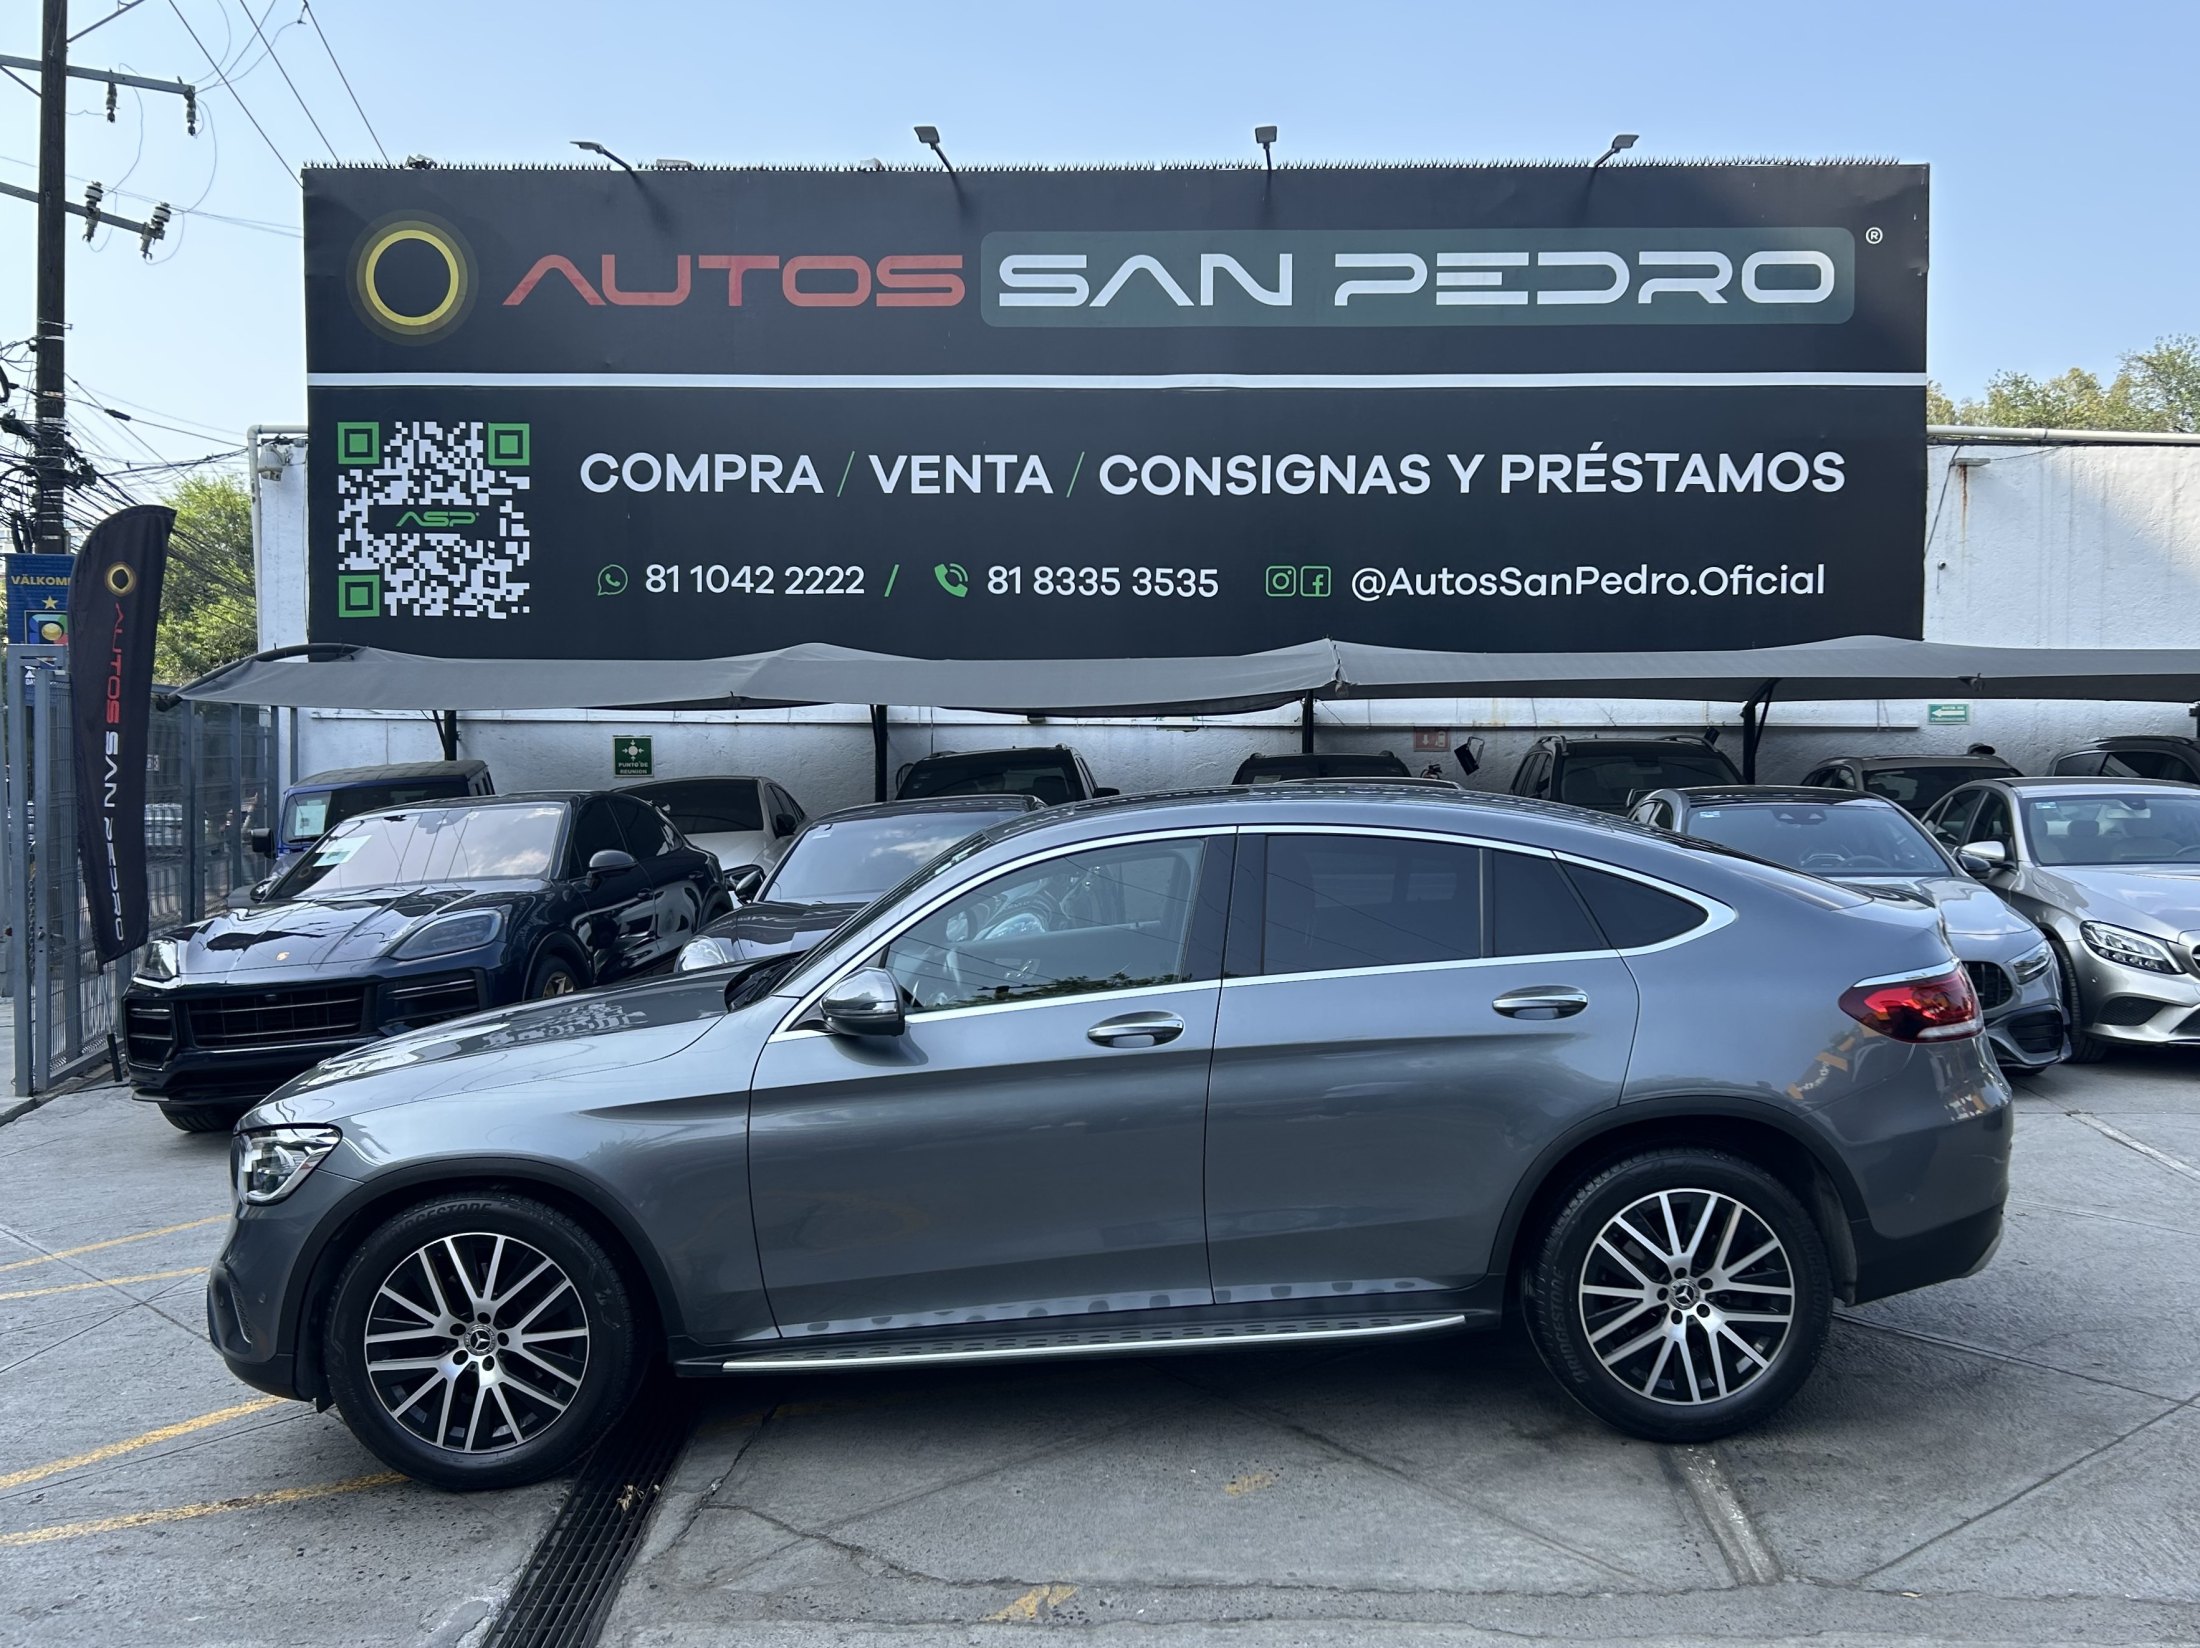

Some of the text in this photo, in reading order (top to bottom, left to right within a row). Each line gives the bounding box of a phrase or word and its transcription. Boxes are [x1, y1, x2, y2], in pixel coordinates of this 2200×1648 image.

[503, 254, 966, 307] AUTOS
[999, 252, 1293, 307] SAN
[1334, 250, 1835, 306] PEDRO
[580, 452, 825, 495] COMPRA
[868, 454, 1054, 495] VENTA
[1099, 453, 1431, 497] CONSIGNAS
[1446, 453, 1486, 495] Y
[1500, 441, 1845, 495] PRÉSTAMOS
[396, 511, 476, 527] ASP
[645, 563, 679, 594] 81
[689, 564, 775, 596] 1042
[784, 565, 865, 596] 2222
[987, 565, 1021, 596] 81
[1033, 565, 1121, 598] 8335
[1131, 566, 1219, 598] 3535
[1351, 563, 1825, 602] @AutosSanPedro.Oficial
[103, 602, 125, 941] AUTOS SAN PEDRO
